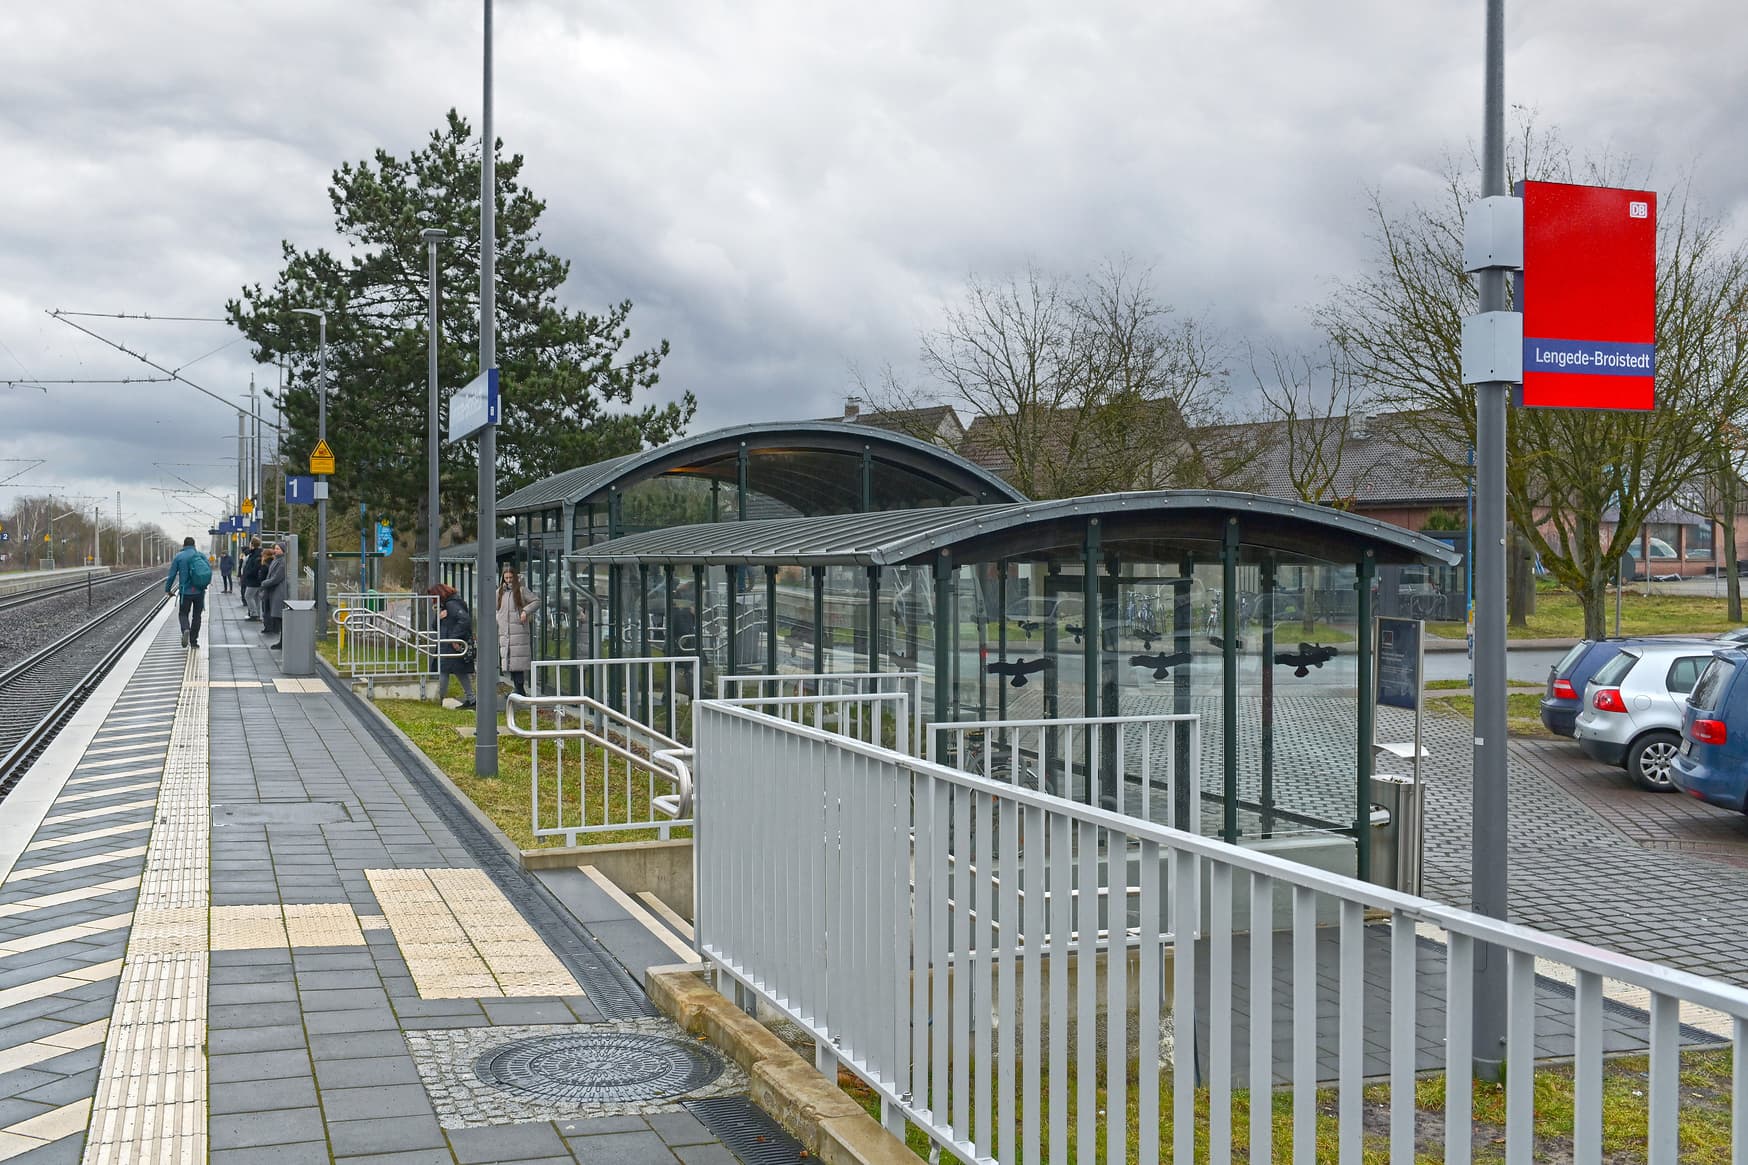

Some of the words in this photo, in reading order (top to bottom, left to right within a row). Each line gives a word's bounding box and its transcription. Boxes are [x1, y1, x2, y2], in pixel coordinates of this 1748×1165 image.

[1631, 203, 1646, 217] DB
[1536, 347, 1650, 369] Lengede-Broistedt
[289, 478, 298, 498] 1
[230, 516, 236, 527] 1
